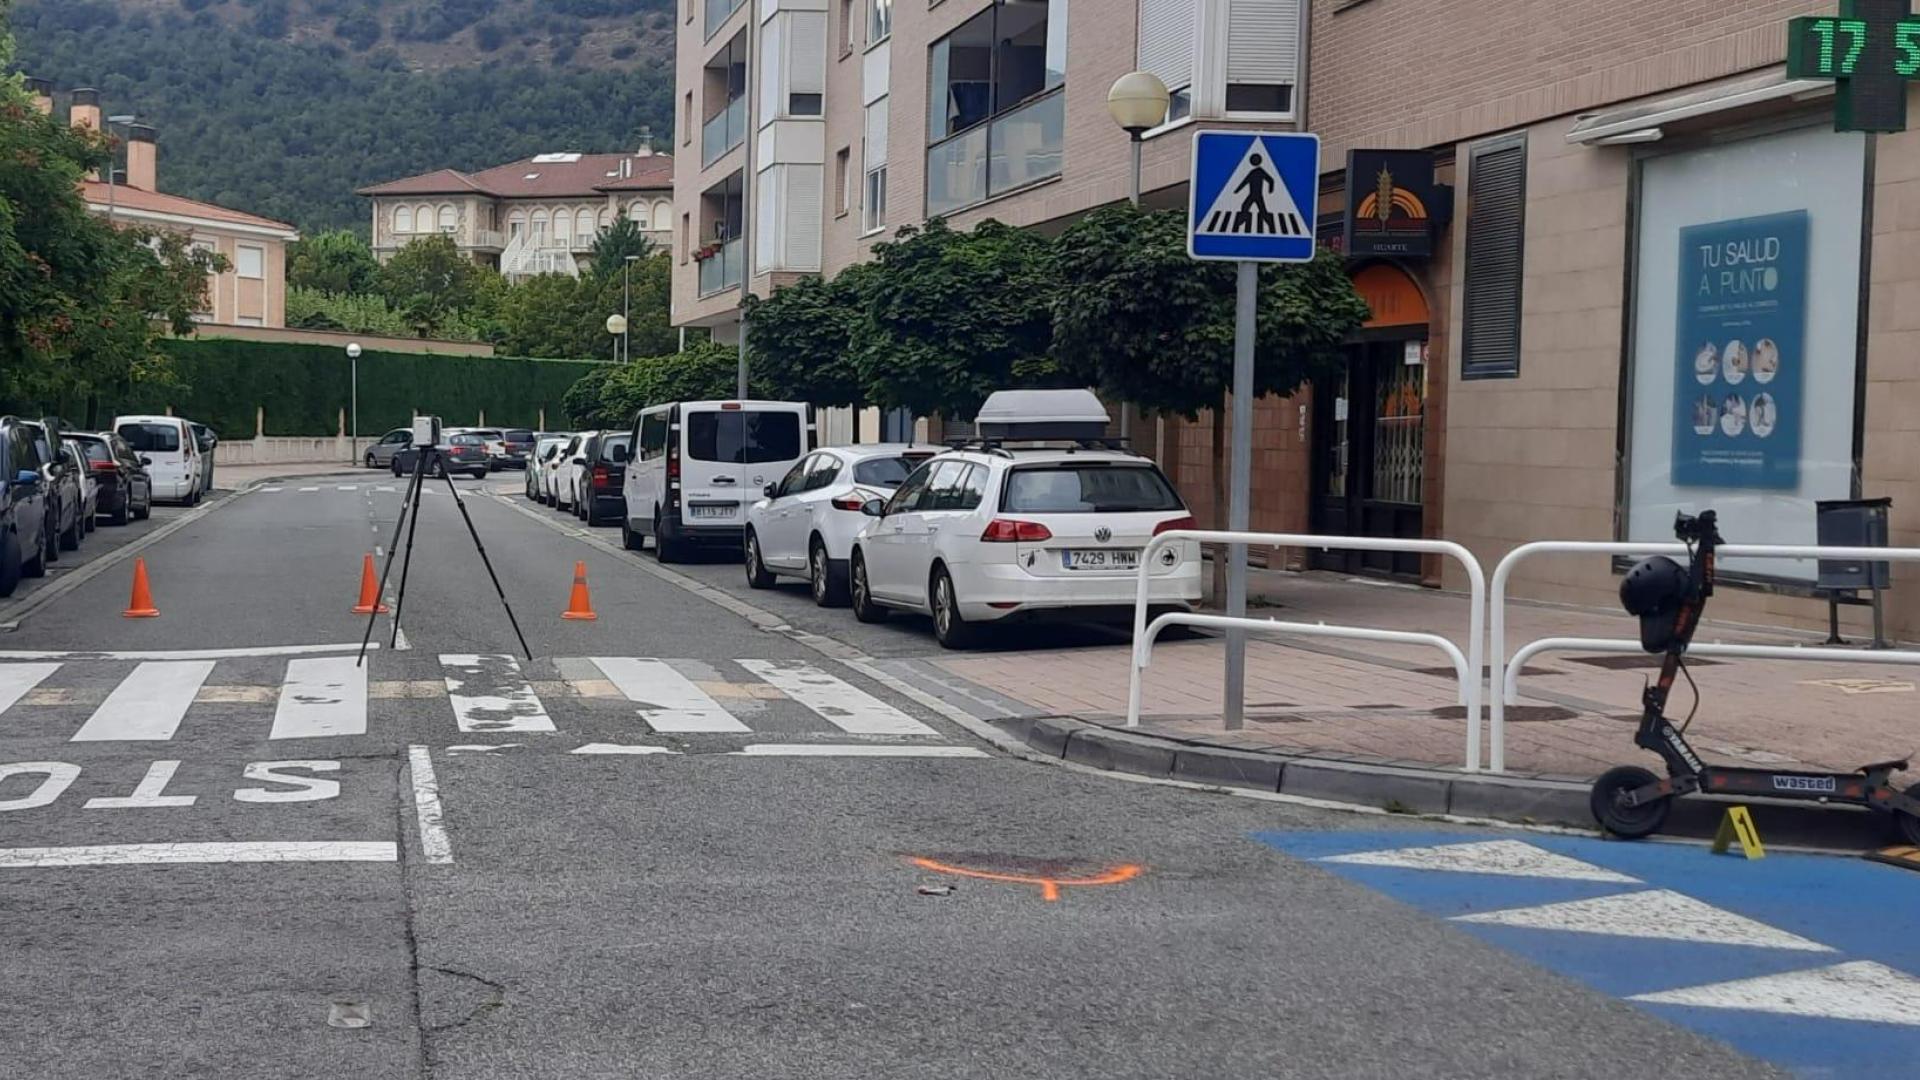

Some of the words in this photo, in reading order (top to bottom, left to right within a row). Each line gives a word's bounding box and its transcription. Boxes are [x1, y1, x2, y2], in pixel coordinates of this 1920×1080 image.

[1809, 20, 1866, 73] 17
[1698, 244, 1721, 269] TU
[1725, 237, 1780, 266] SALUD
[1698, 273, 1711, 296] A
[1720, 267, 1778, 296] PUNTO
[1073, 551, 1105, 565] 7429
[1775, 776, 1833, 790] wasted
[1737, 812, 1756, 847] 1
